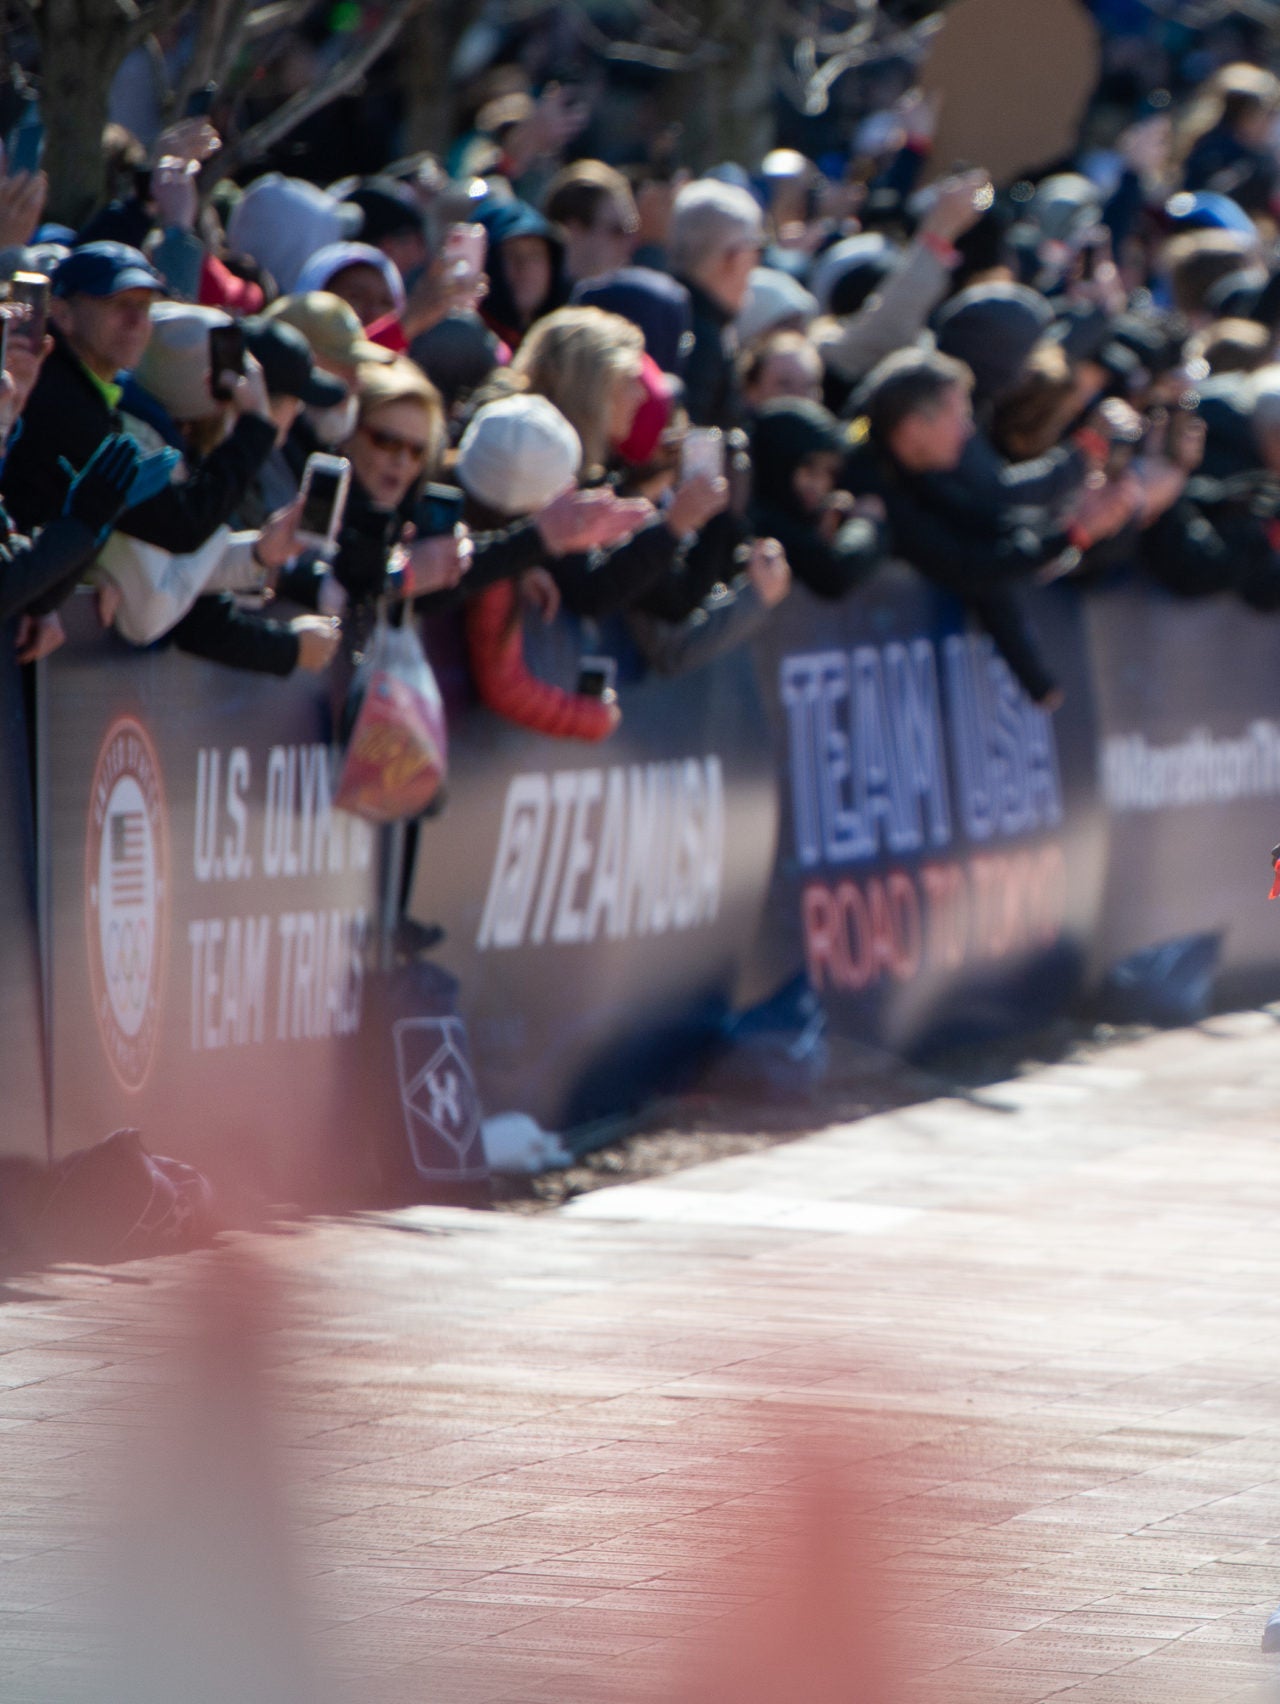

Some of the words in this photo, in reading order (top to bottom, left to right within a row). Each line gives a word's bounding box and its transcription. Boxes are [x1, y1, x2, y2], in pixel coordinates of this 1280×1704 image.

[194, 746, 252, 881] U.S.
[780, 638, 953, 868] TEAM
[188, 914, 269, 1049] TEAM
[803, 869, 923, 991] ROAD
